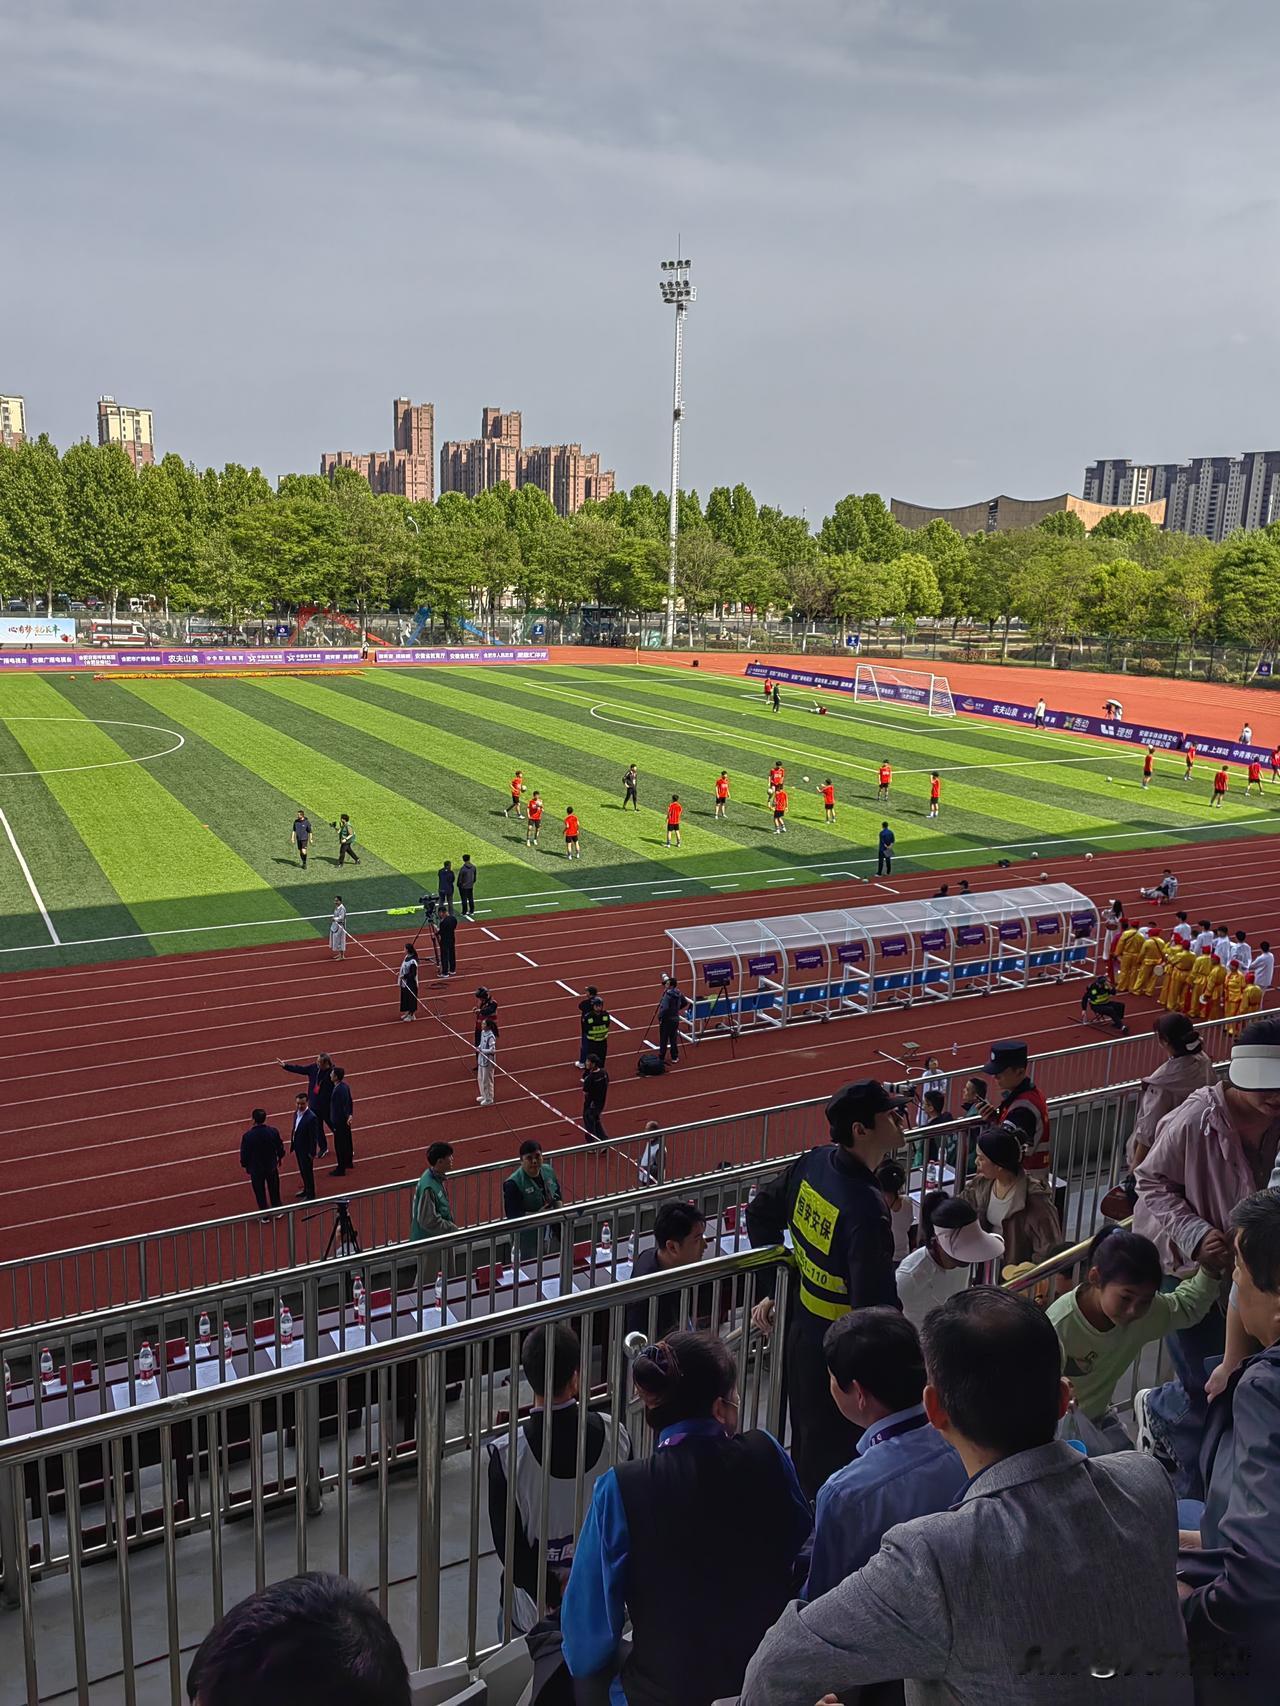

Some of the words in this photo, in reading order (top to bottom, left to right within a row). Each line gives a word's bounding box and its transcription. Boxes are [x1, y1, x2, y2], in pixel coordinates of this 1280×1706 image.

[168, 655, 198, 663] 农夫山泉
[992, 705, 1019, 717] 农夫山泉
[1116, 727, 1133, 739] 理想
